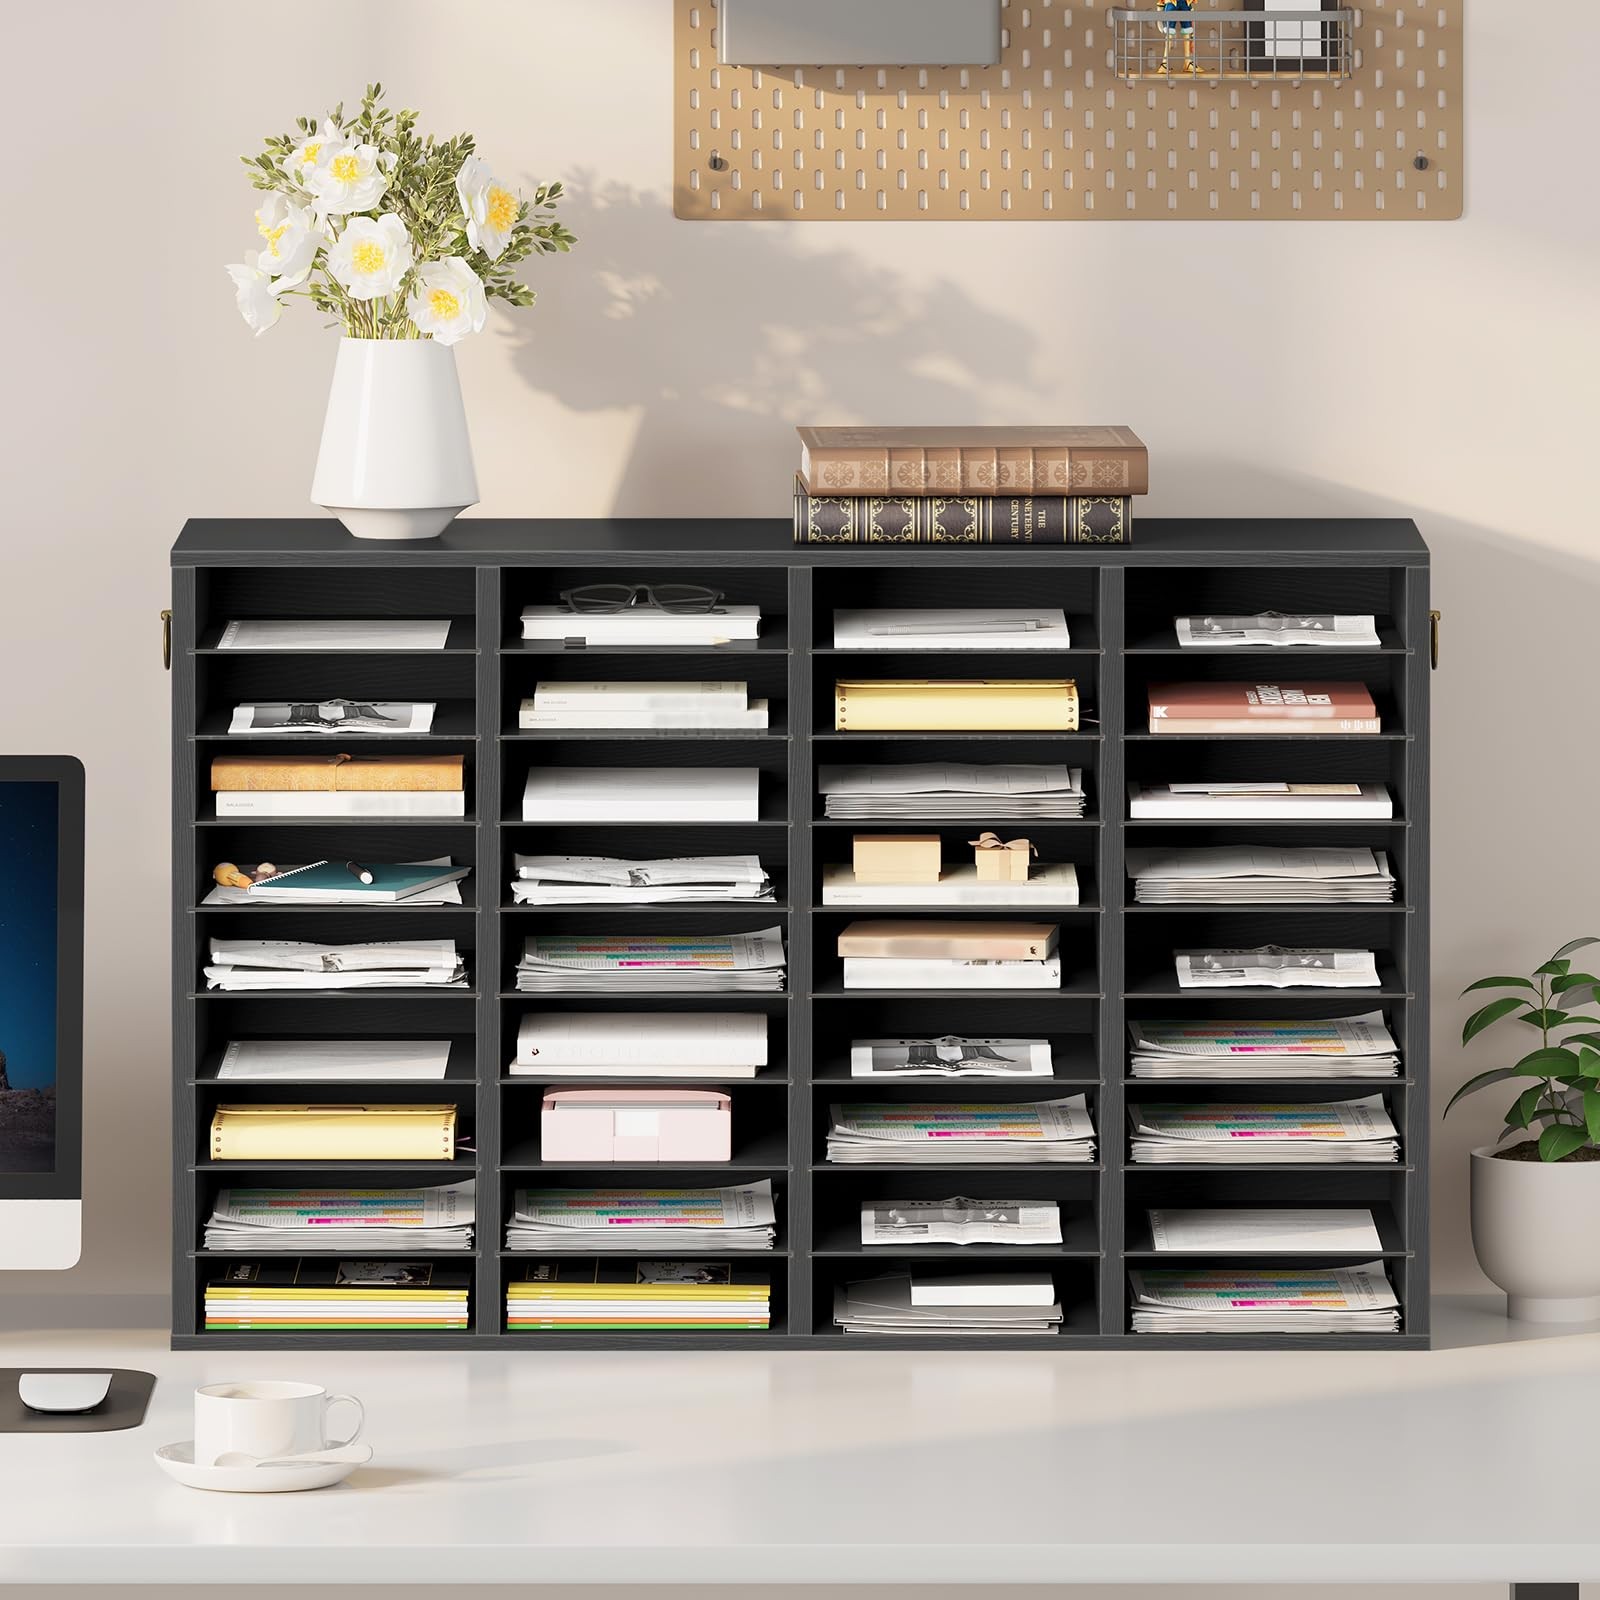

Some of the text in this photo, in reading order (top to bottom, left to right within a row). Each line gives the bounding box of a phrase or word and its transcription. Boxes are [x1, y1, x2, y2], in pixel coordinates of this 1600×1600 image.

[1011, 499, 1019, 539] CENTURY
[1038, 509, 1046, 529] THE
[1152, 706, 1169, 718] K
